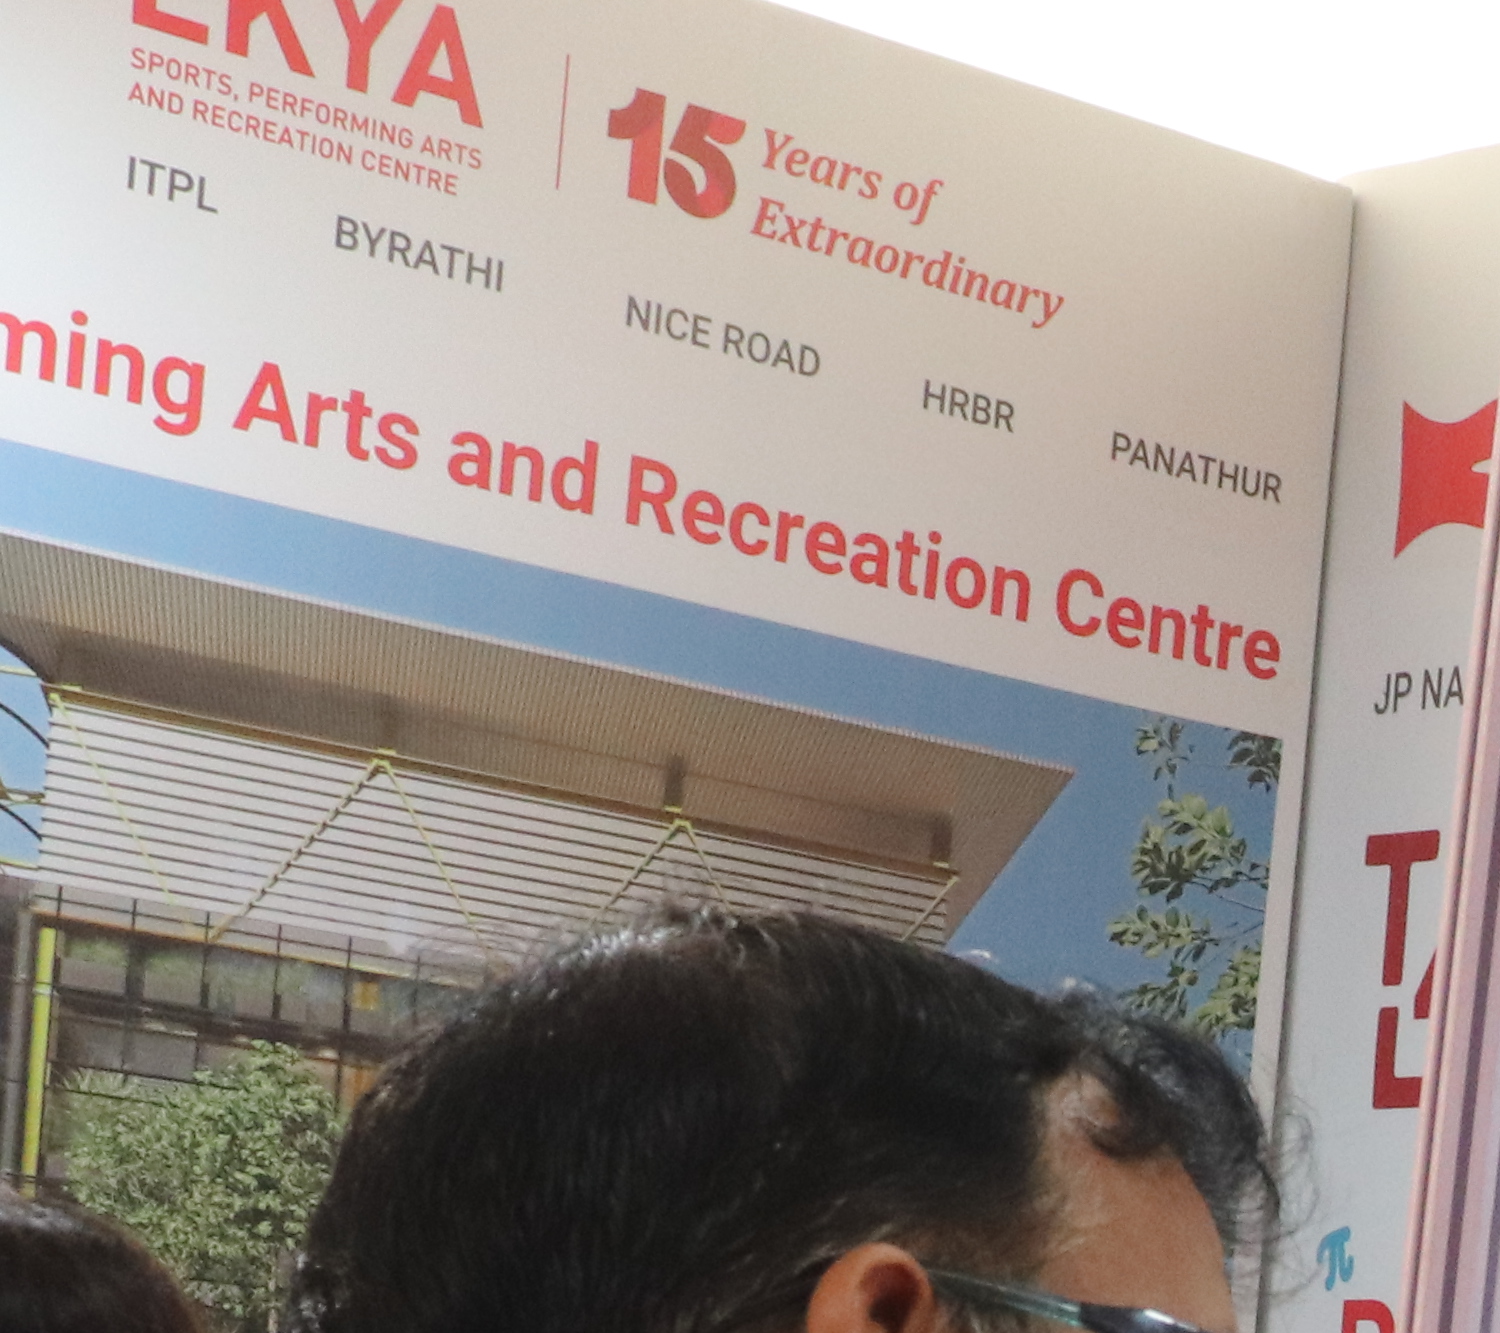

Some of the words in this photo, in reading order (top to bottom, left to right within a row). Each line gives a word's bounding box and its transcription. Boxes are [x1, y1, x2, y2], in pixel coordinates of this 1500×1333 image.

[128, 84, 188, 118] AND
[194, 98, 355, 175] RECREATION
[360, 143, 458, 197] CENTRE
[129, 47, 243, 104] SPORTS,
[248, 79, 415, 153] PERFORMING
[418, 127, 482, 171] ARTS
[128, 157, 218, 214] ITPL
[610, 90, 745, 217] 15
[758, 129, 882, 214] Years
[893, 179, 944, 225] of
[336, 216, 503, 292] BYRATHI
[752, 189, 1065, 328] Extraordinary
[626, 296, 712, 349] NICE
[723, 324, 820, 377] ROAD
[923, 380, 1014, 432] HRBR
[1112, 432, 1282, 504] PANATHUR
[234, 362, 417, 469] Arts
[448, 432, 598, 514] and
[627, 456, 1030, 621] Recreation
[1057, 569, 1280, 679] Centre
[1374, 672, 1412, 715] JP
